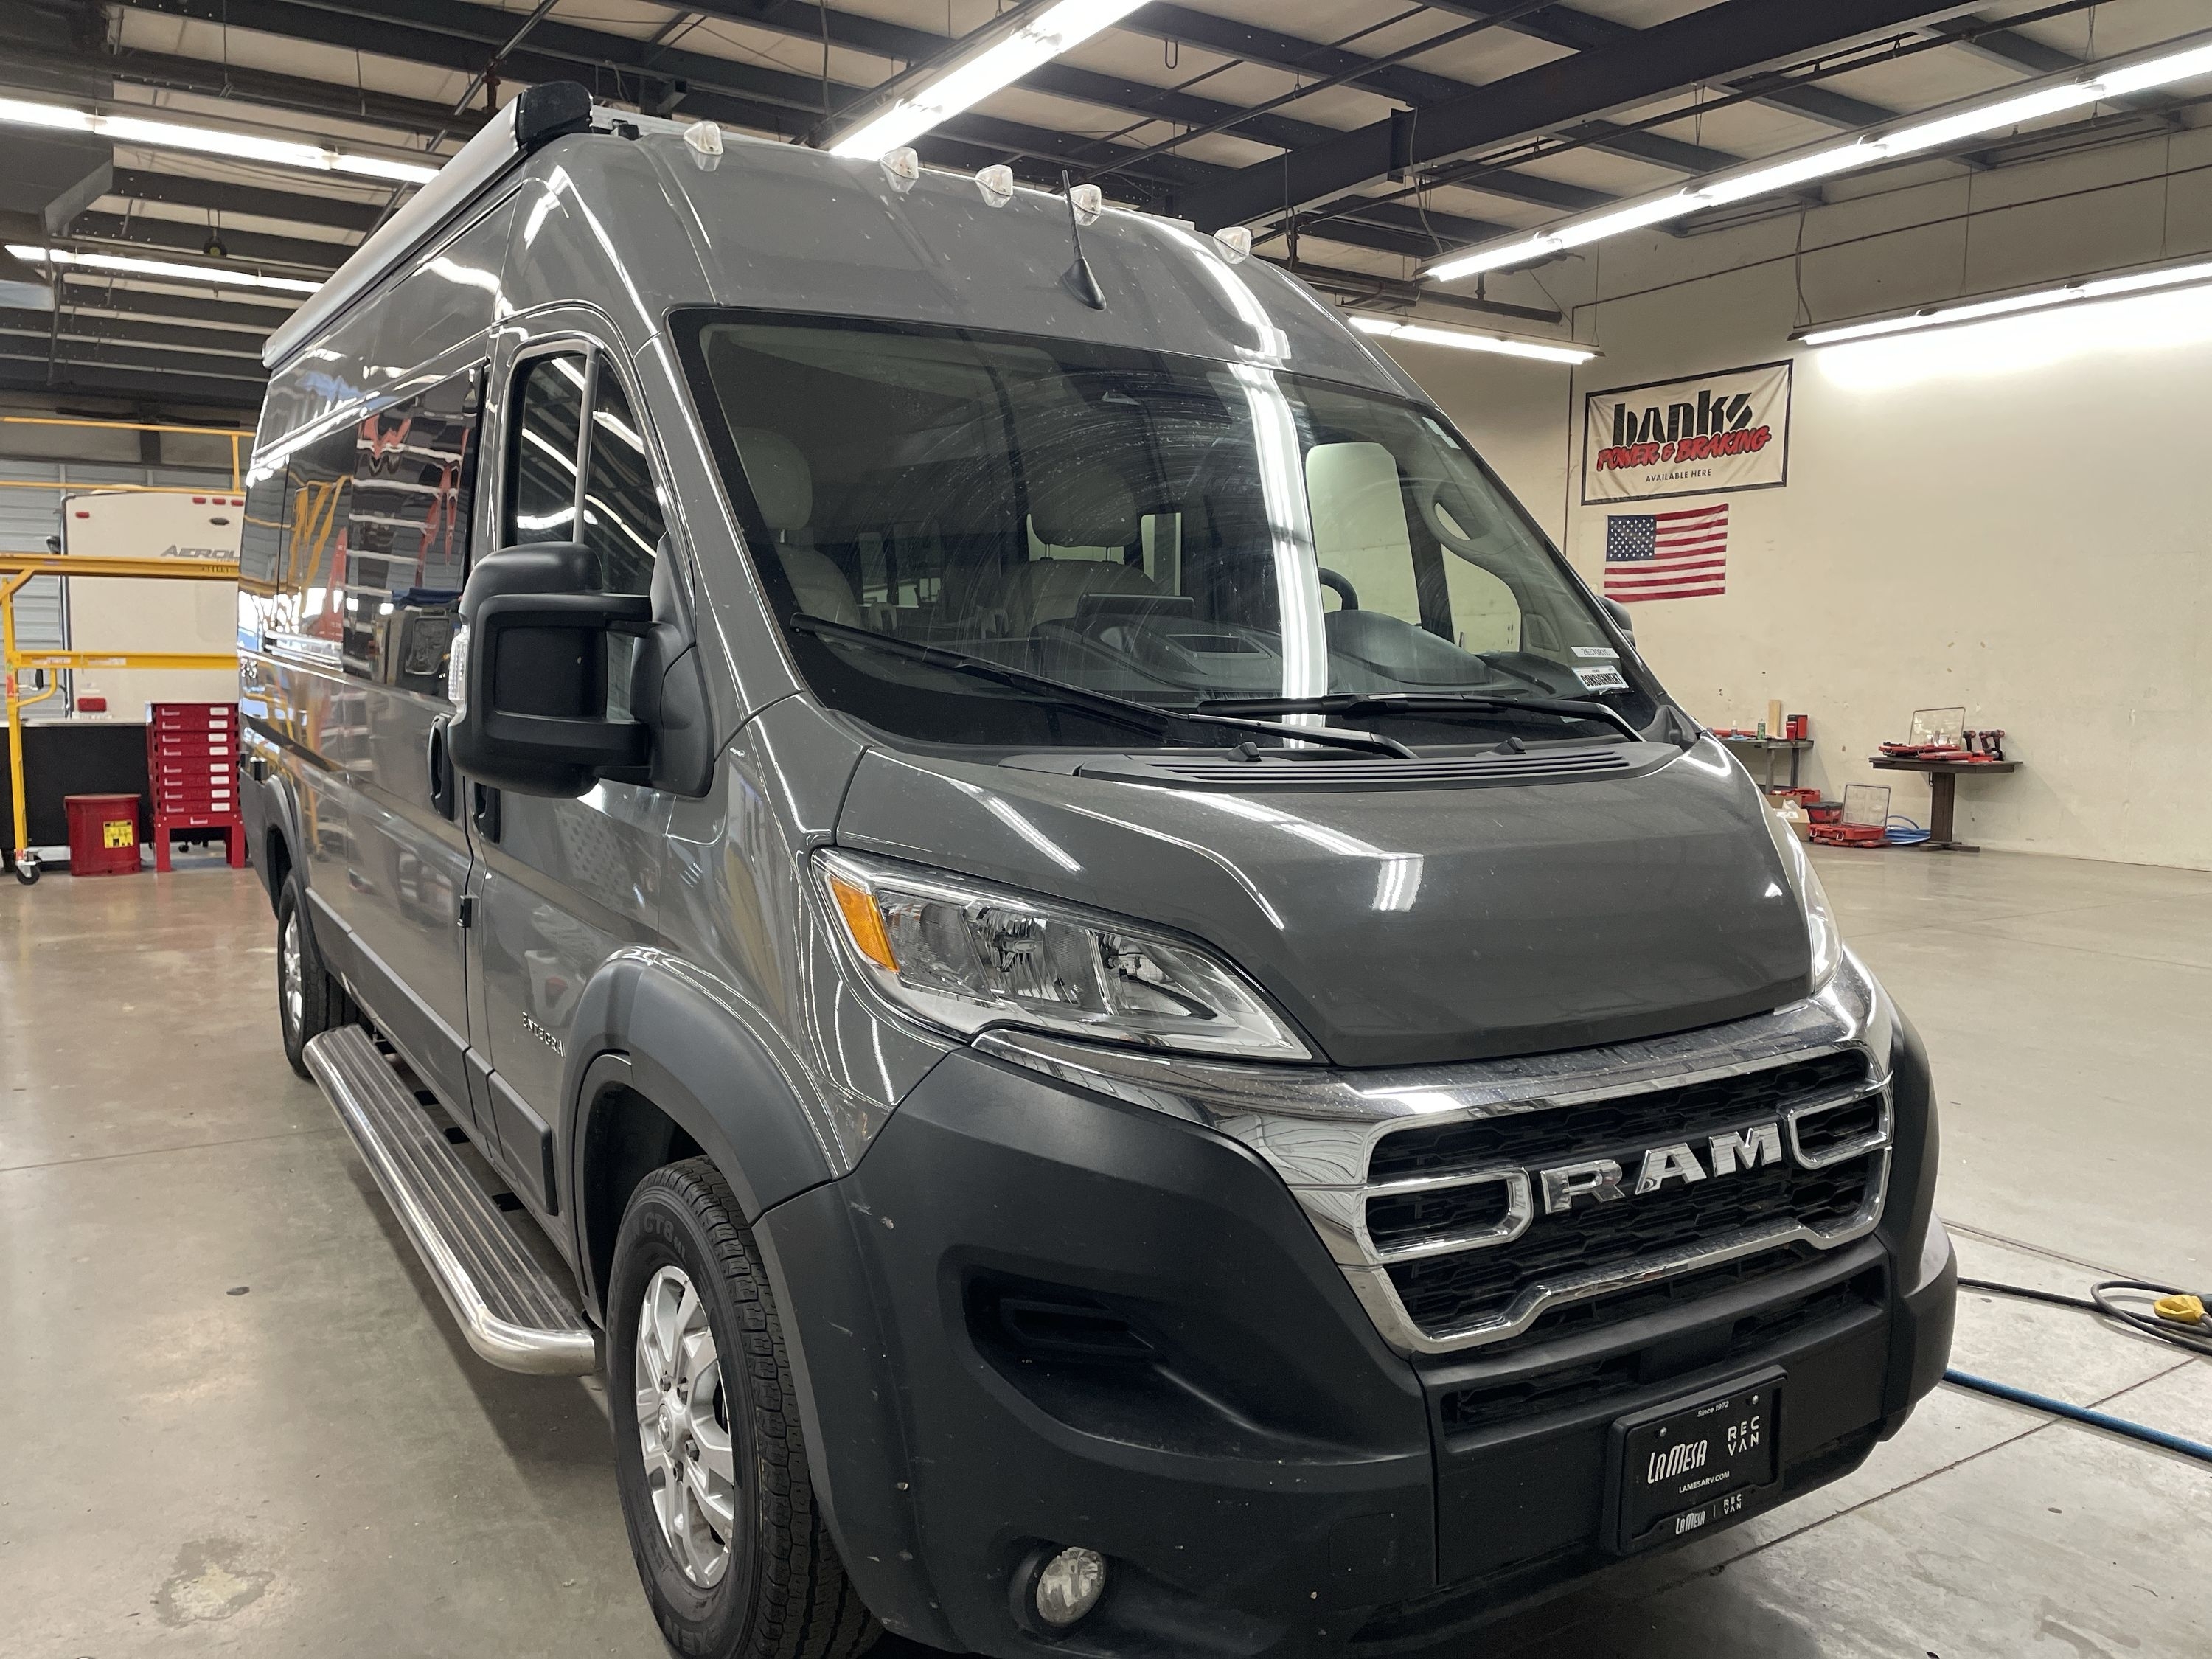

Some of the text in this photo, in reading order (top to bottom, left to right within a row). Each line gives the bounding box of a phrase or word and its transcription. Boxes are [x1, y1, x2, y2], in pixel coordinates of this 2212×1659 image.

[1613, 389, 1753, 447] banks
[1596, 425, 1772, 472] POWER & BRAKING
[1645, 468, 1712, 483] AVAILABLE HERE
[1580, 672, 1624, 686] CONSIGNMENT
[1540, 1122, 1782, 1214] RAM
[644, 1211, 675, 1243] CT8
[1697, 1400, 1730, 1417] Since 1972
[1728, 1416, 1759, 1441] REC
[1728, 1431, 1759, 1456] VAN
[1679, 1470, 1730, 1493] LAMESARV.COM
[1724, 1494, 1742, 1507] REC
[1724, 1501, 1742, 1514] VAN
